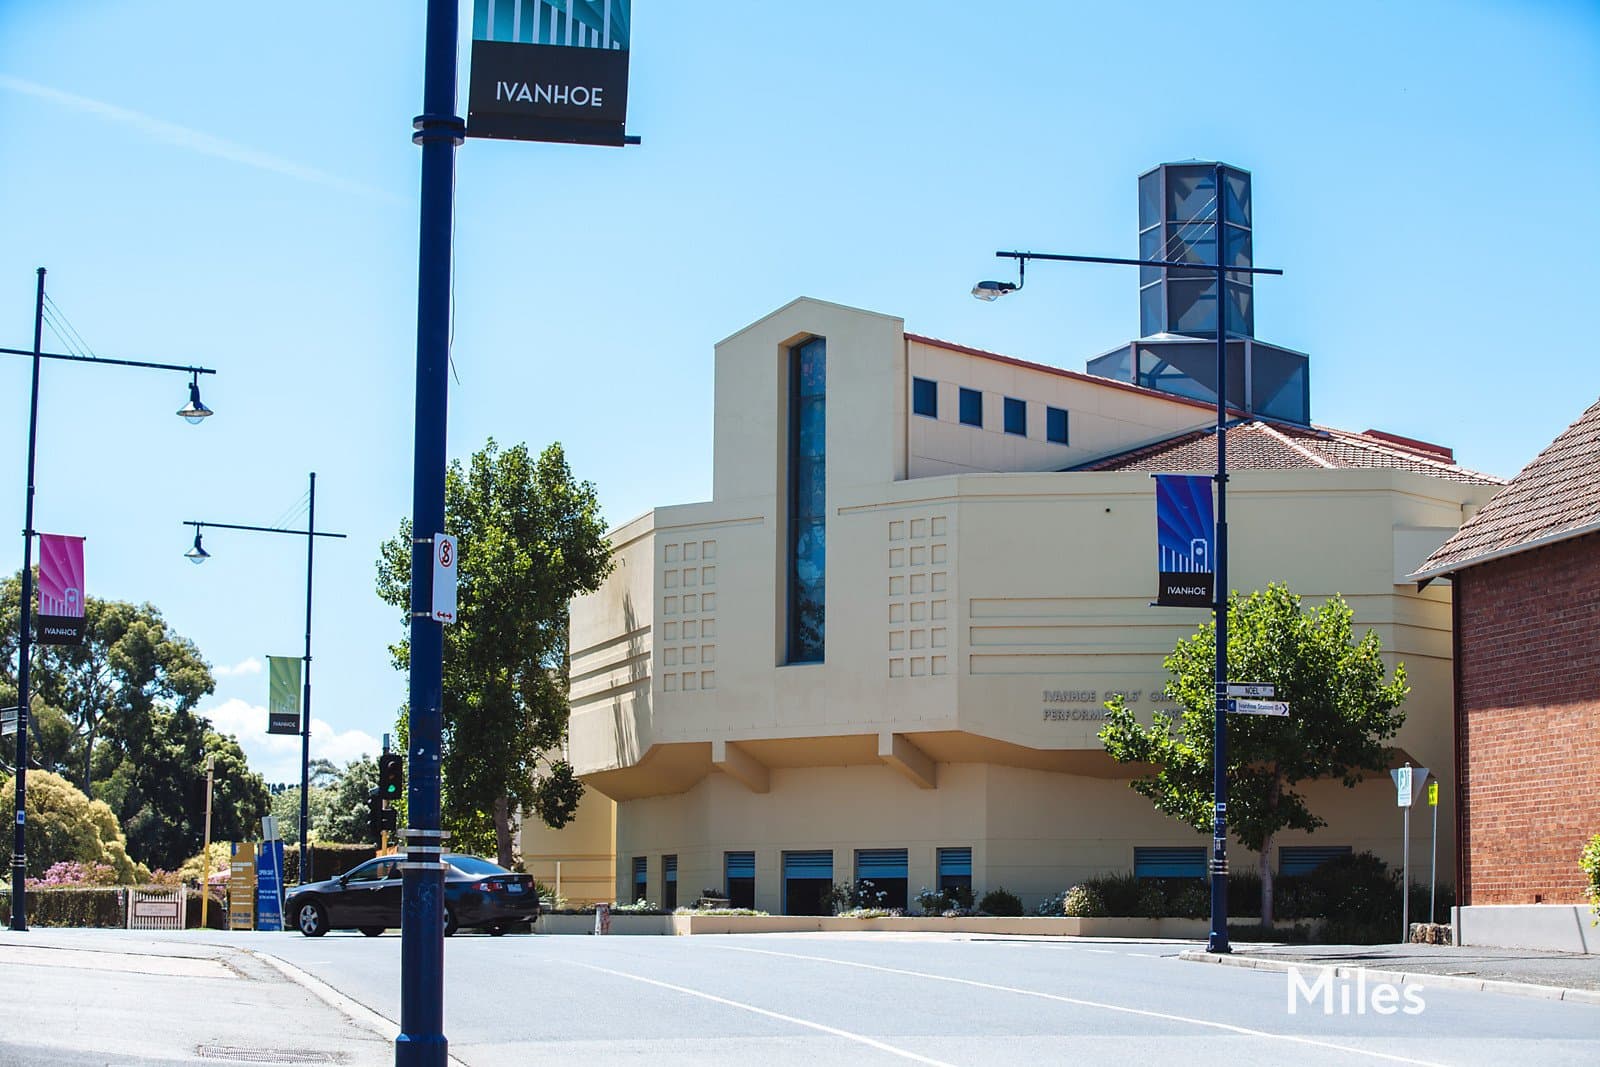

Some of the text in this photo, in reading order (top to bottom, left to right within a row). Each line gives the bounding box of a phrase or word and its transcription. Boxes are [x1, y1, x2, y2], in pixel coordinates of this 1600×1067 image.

[496, 81, 603, 107] IVANHOE
[1167, 586, 1206, 595] IVANHOE
[44, 627, 77, 636] IVANHOE
[1244, 687, 1260, 695] NOEL
[1043, 690, 1096, 702] IVANHOE
